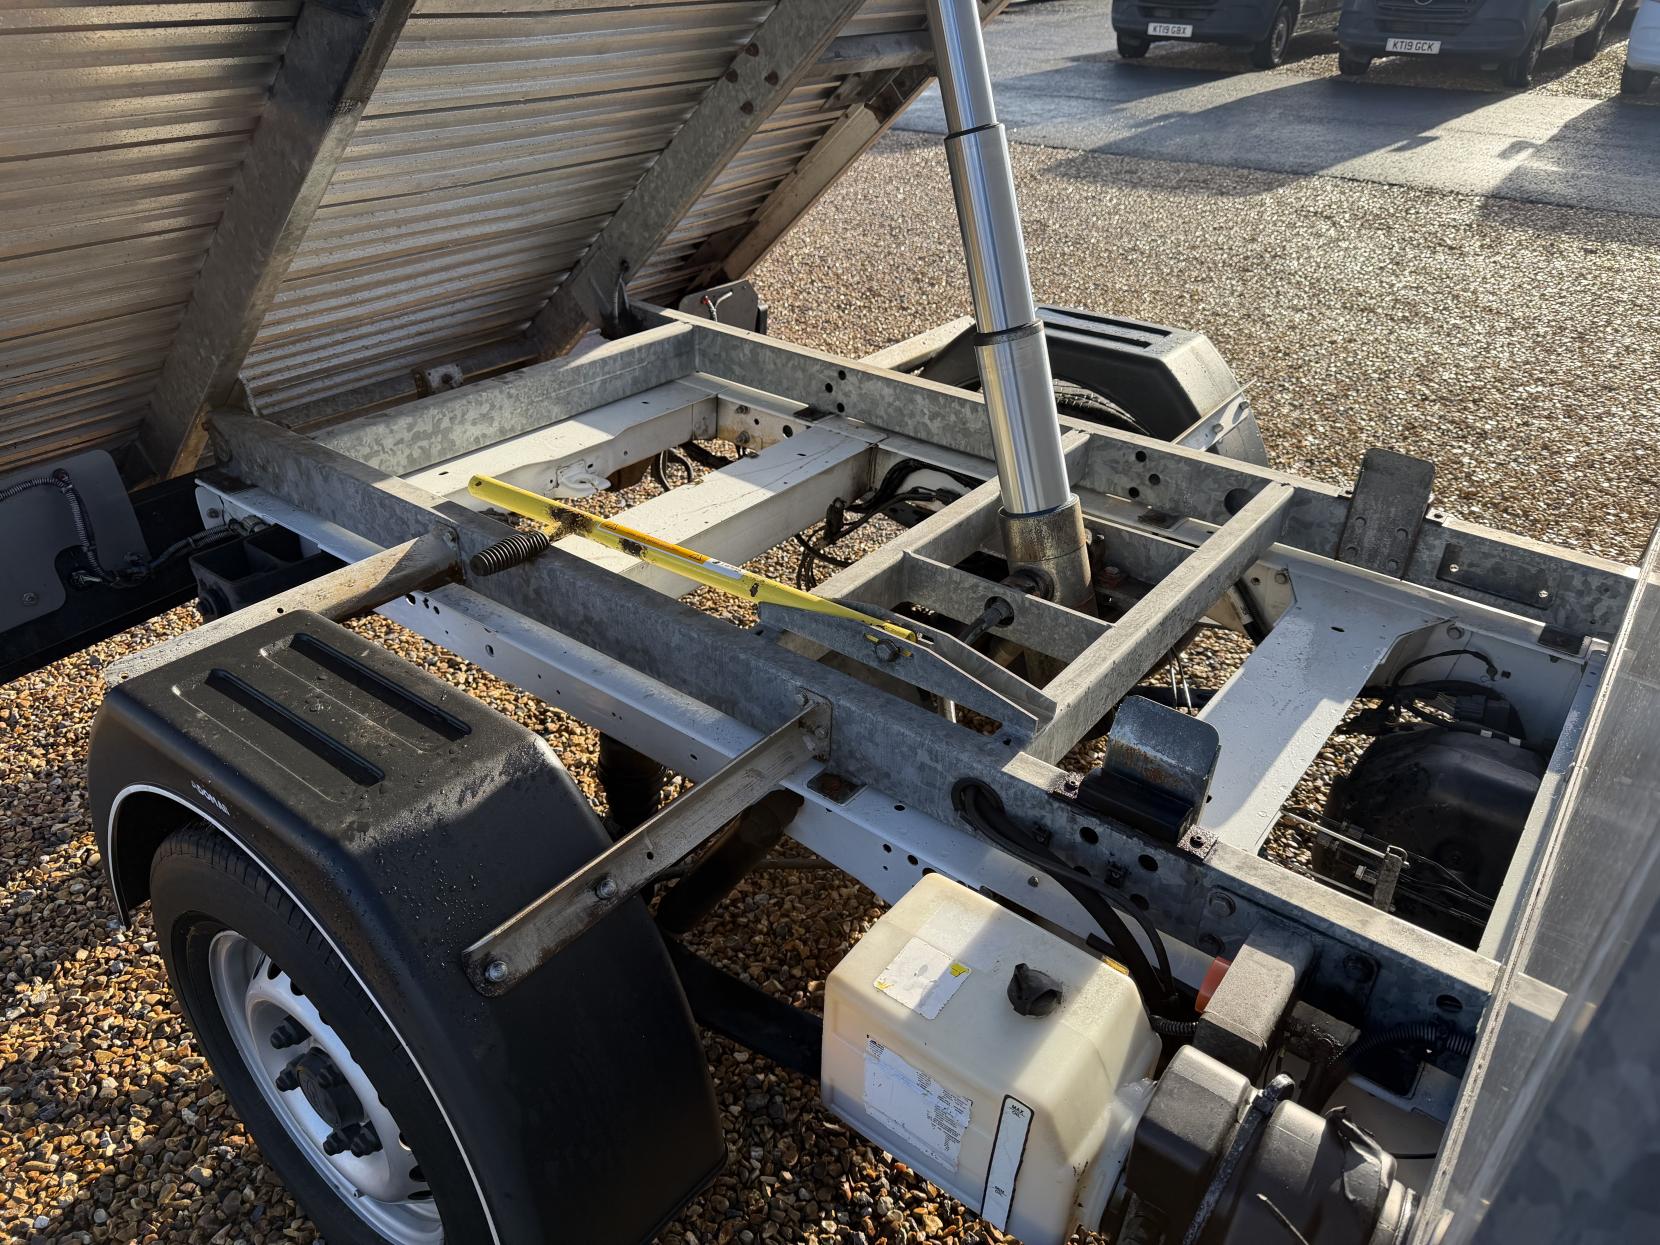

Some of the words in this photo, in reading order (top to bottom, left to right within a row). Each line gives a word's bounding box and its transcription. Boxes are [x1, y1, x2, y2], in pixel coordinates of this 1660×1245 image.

[1152, 25, 1169, 34] KT19
[1393, 40, 1413, 51] KT19
[1415, 41, 1434, 52] GCK
[1011, 1104, 1024, 1114] MAX
